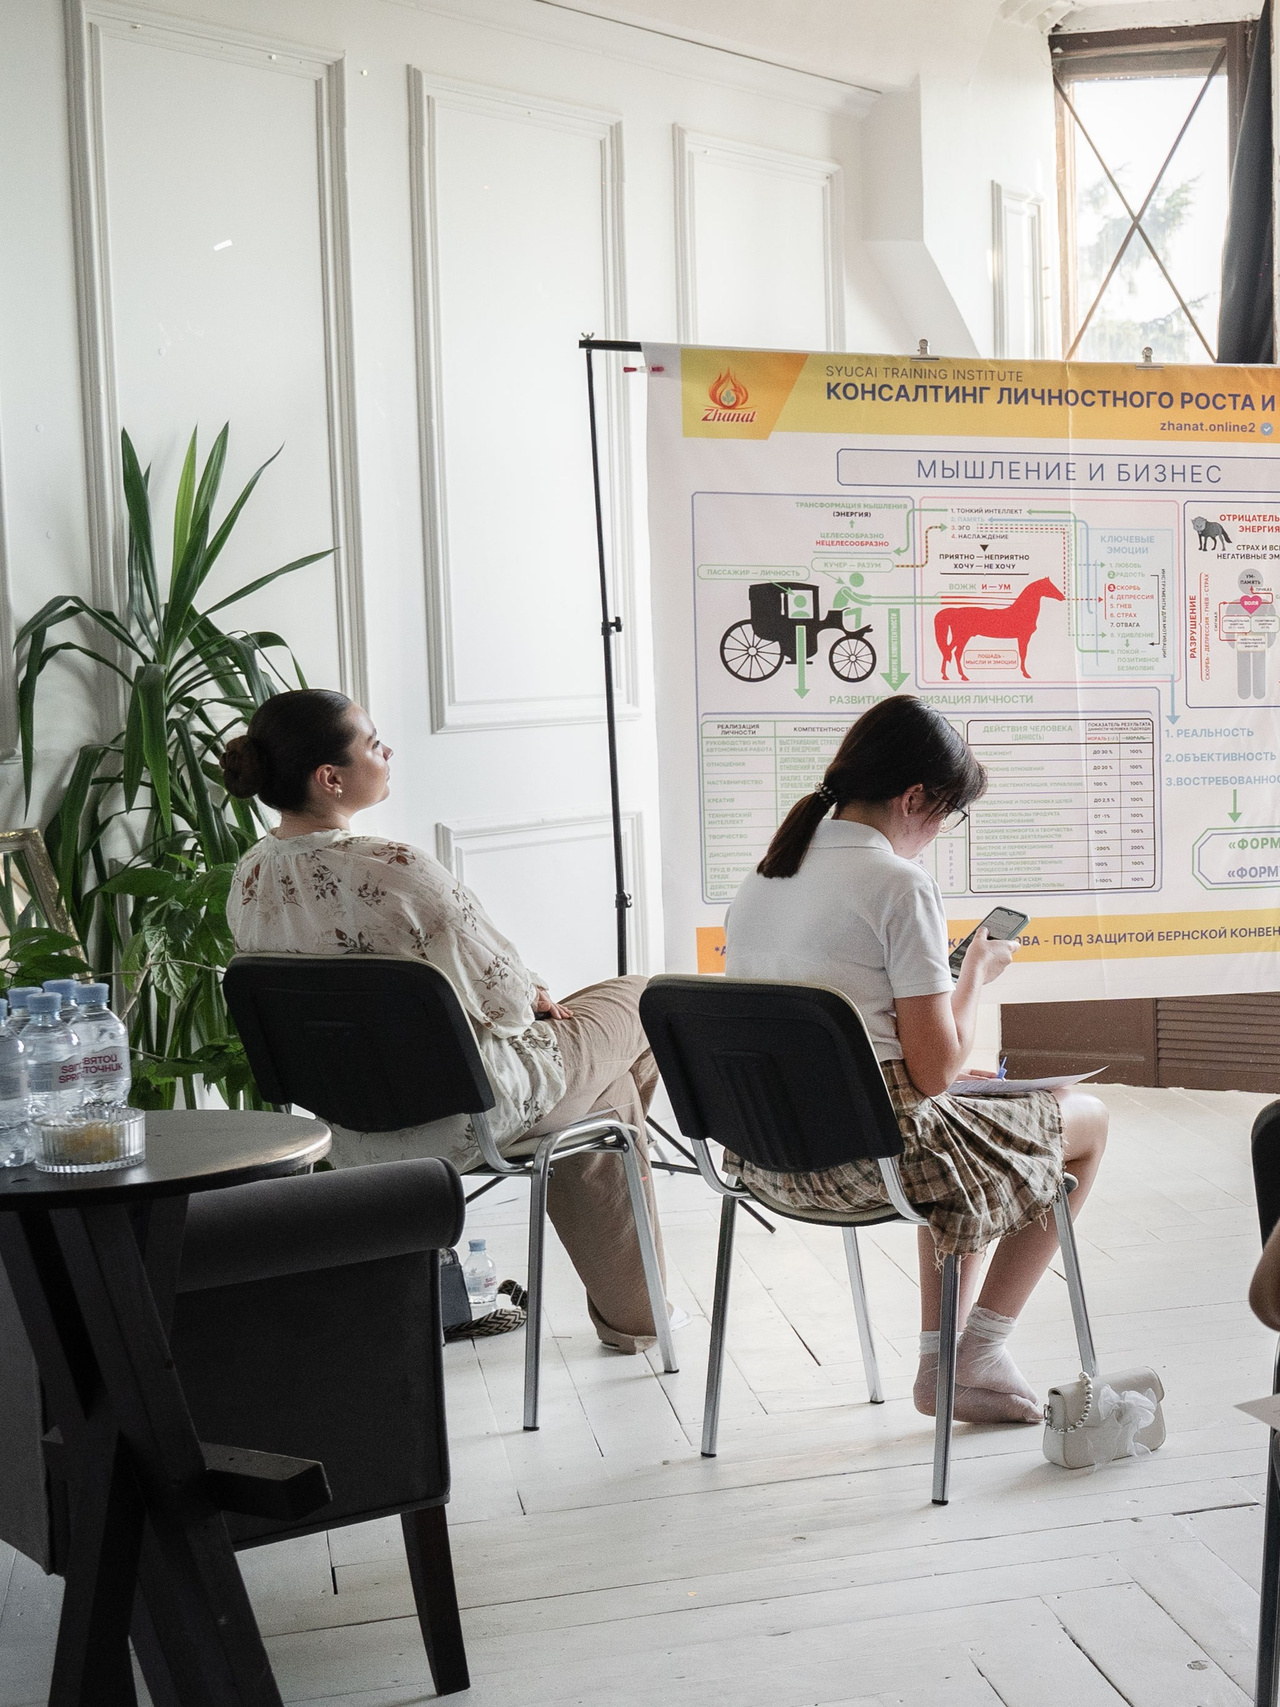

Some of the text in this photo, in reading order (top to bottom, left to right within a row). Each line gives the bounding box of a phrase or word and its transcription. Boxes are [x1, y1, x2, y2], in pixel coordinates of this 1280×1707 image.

[826, 366, 1024, 382] SYUCAI TRAINING INSTITUTE
[826, 382, 991, 405] КОНСАЛТИНГ
[997, 386, 1175, 410] ЛИЧНОСТНОГО
[1180, 392, 1256, 412] РОСТА
[1261, 395, 1275, 412] И
[701, 408, 757, 423] Zhanat
[1160, 420, 1256, 434] zhanat.online2
[916, 459, 1222, 484] МЫШЛЕНИЕ И БИЗНЕС
[795, 502, 908, 510] ТРАНСФОРМАЦИЯ МЫШЛЕНИЯ
[957, 507, 983, 515] ТОНКИЙ
[1238, 525, 1280, 533] ЭНЕРГИЯ
[820, 532, 885, 540] ЦЕЛЕСООБРАЗНО
[1100, 535, 1155, 543] КЛЮЧЕВЫЕ
[815, 540, 890, 548] НЕЦЕЛЕСООБРАЗНО
[1106, 546, 1149, 555] ЭМОЦИИ
[824, 561, 882, 569] КУЧЕР РАЗУМ
[707, 569, 801, 577] ПАССАЖИР ЛИЧНОСТЬ
[1189, 595, 1197, 659] РАЗРУШЕНИЕ
[973, 695, 1034, 704] ЛИЧНОСТИ
[983, 724, 1073, 734] ДЕЙСТВИЯ ЧЕЛОВЕКА
[1165, 727, 1254, 738] 1. РЕАЛЬНОСТЬ
[1165, 751, 1277, 763] 2.ОБЪЕКТИВНОСТЬ
[1053, 933, 1083, 947] ПОД
[1086, 929, 1154, 946] ЗАЩИТОЙ
[1157, 926, 1228, 942] БЕРНСКОЙ
[83, 1054, 118, 1065] ВЯТОЙ
